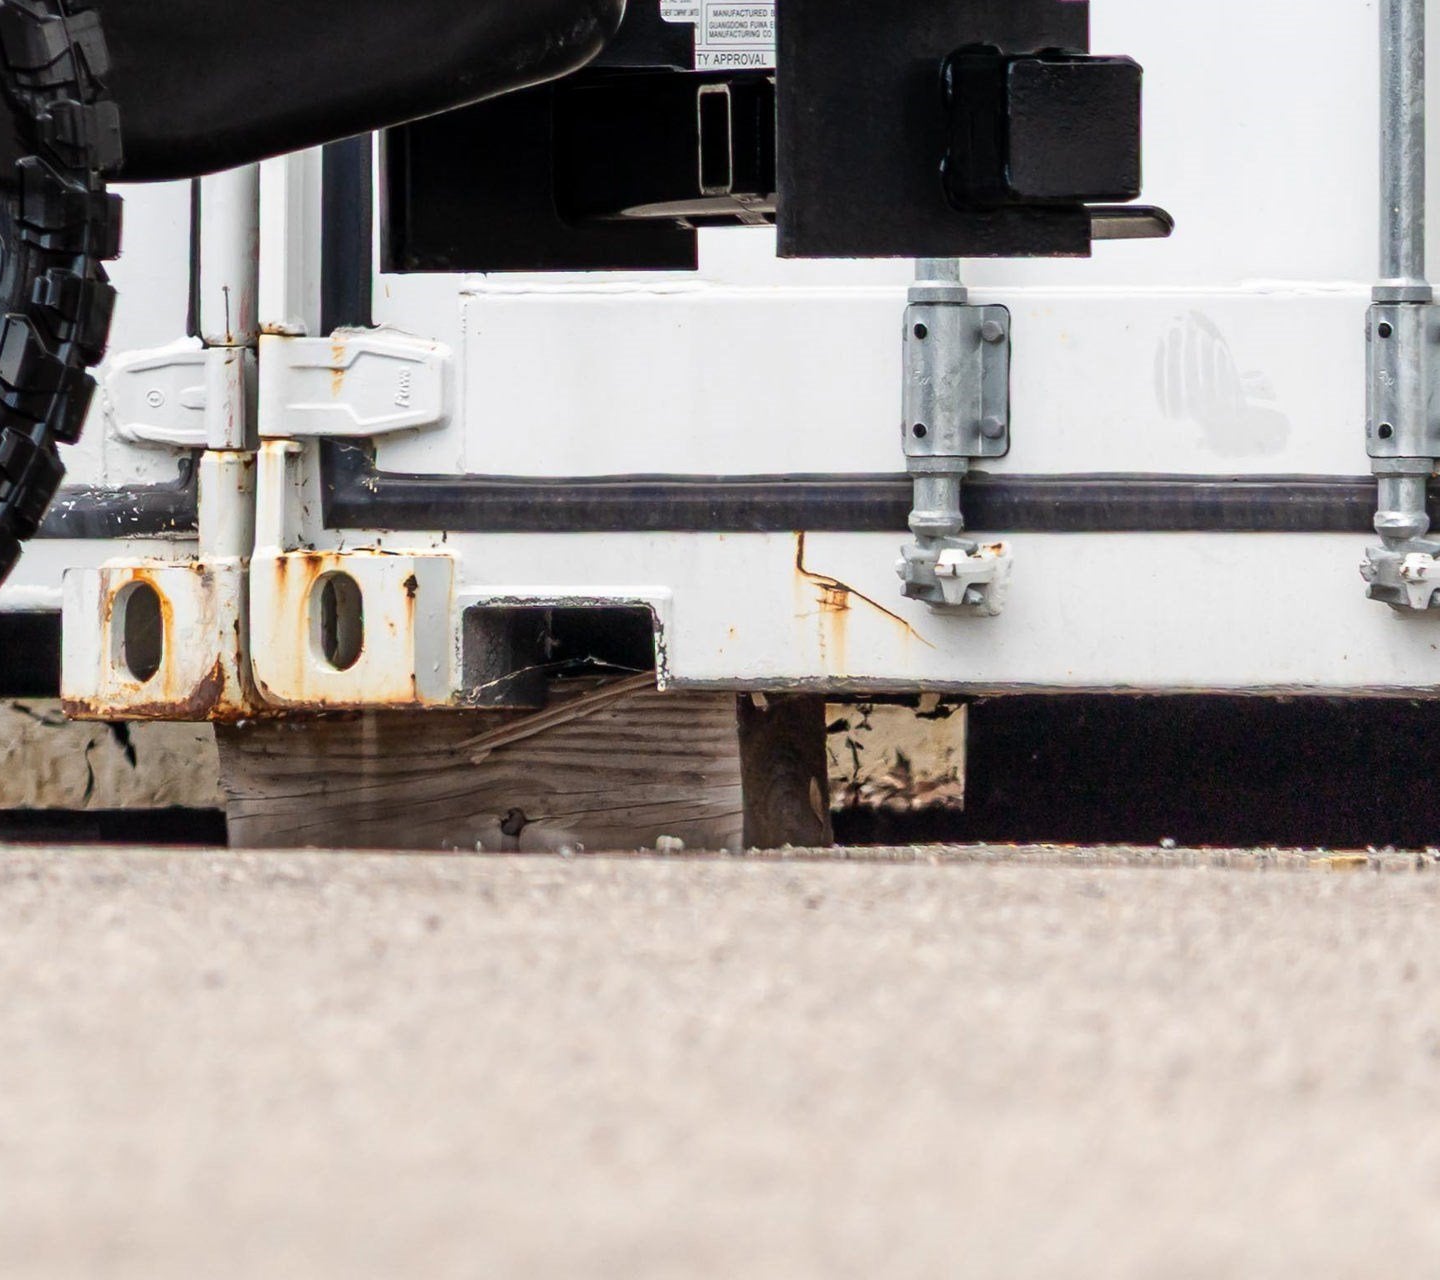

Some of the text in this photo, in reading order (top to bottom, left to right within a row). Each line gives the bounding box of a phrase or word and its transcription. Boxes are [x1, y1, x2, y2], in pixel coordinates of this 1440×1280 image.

[713, 9, 767, 18] MANUFACTURED
[709, 21, 748, 29] GUANGDONG
[709, 30, 760, 38] MANUFACTURING
[713, 53, 767, 65] APPROVAL
